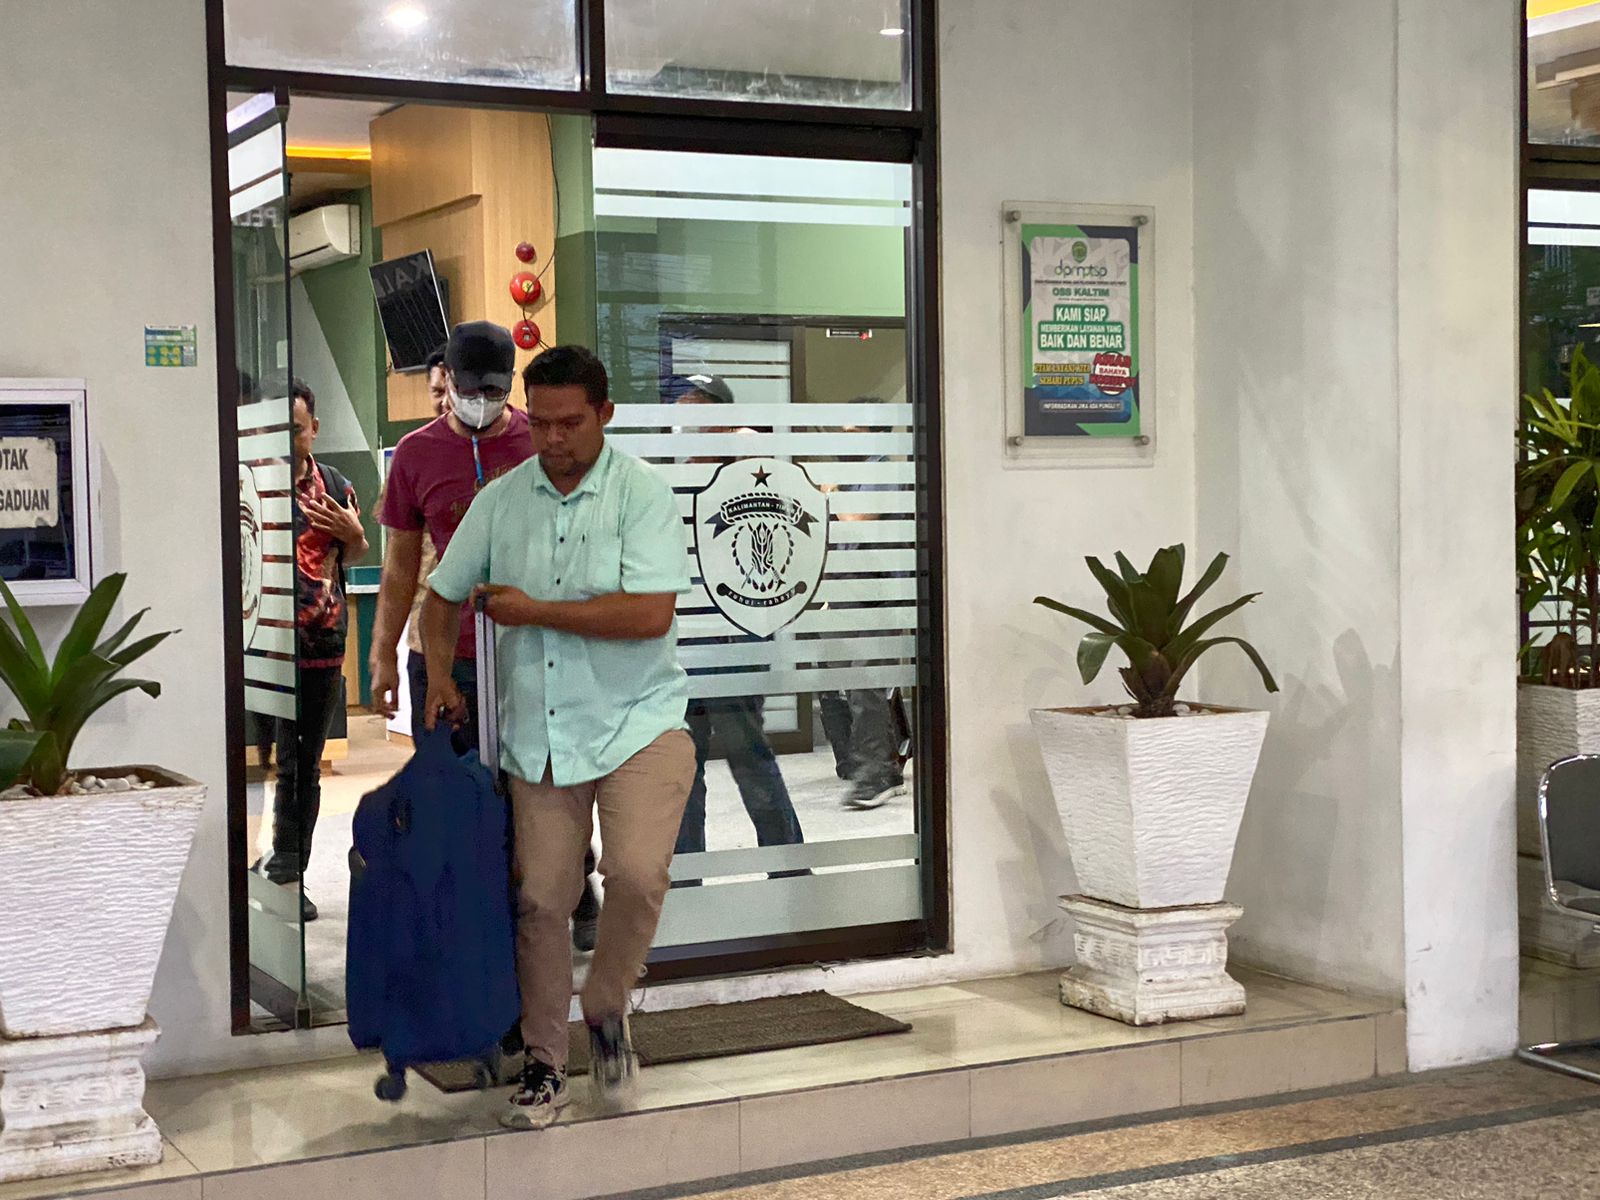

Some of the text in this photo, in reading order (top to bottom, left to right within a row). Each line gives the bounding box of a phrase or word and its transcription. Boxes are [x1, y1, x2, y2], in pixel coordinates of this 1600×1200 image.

[1052, 287, 1110, 297] OSS KALTIM
[1056, 307, 1106, 321] KAMI SIAP
[1106, 325, 1122, 333] YANG
[1040, 334, 1123, 349] BAIK DAN BENAR
[1099, 368, 1127, 376] BAHAYA
[0, 448, 28, 471] TAK
